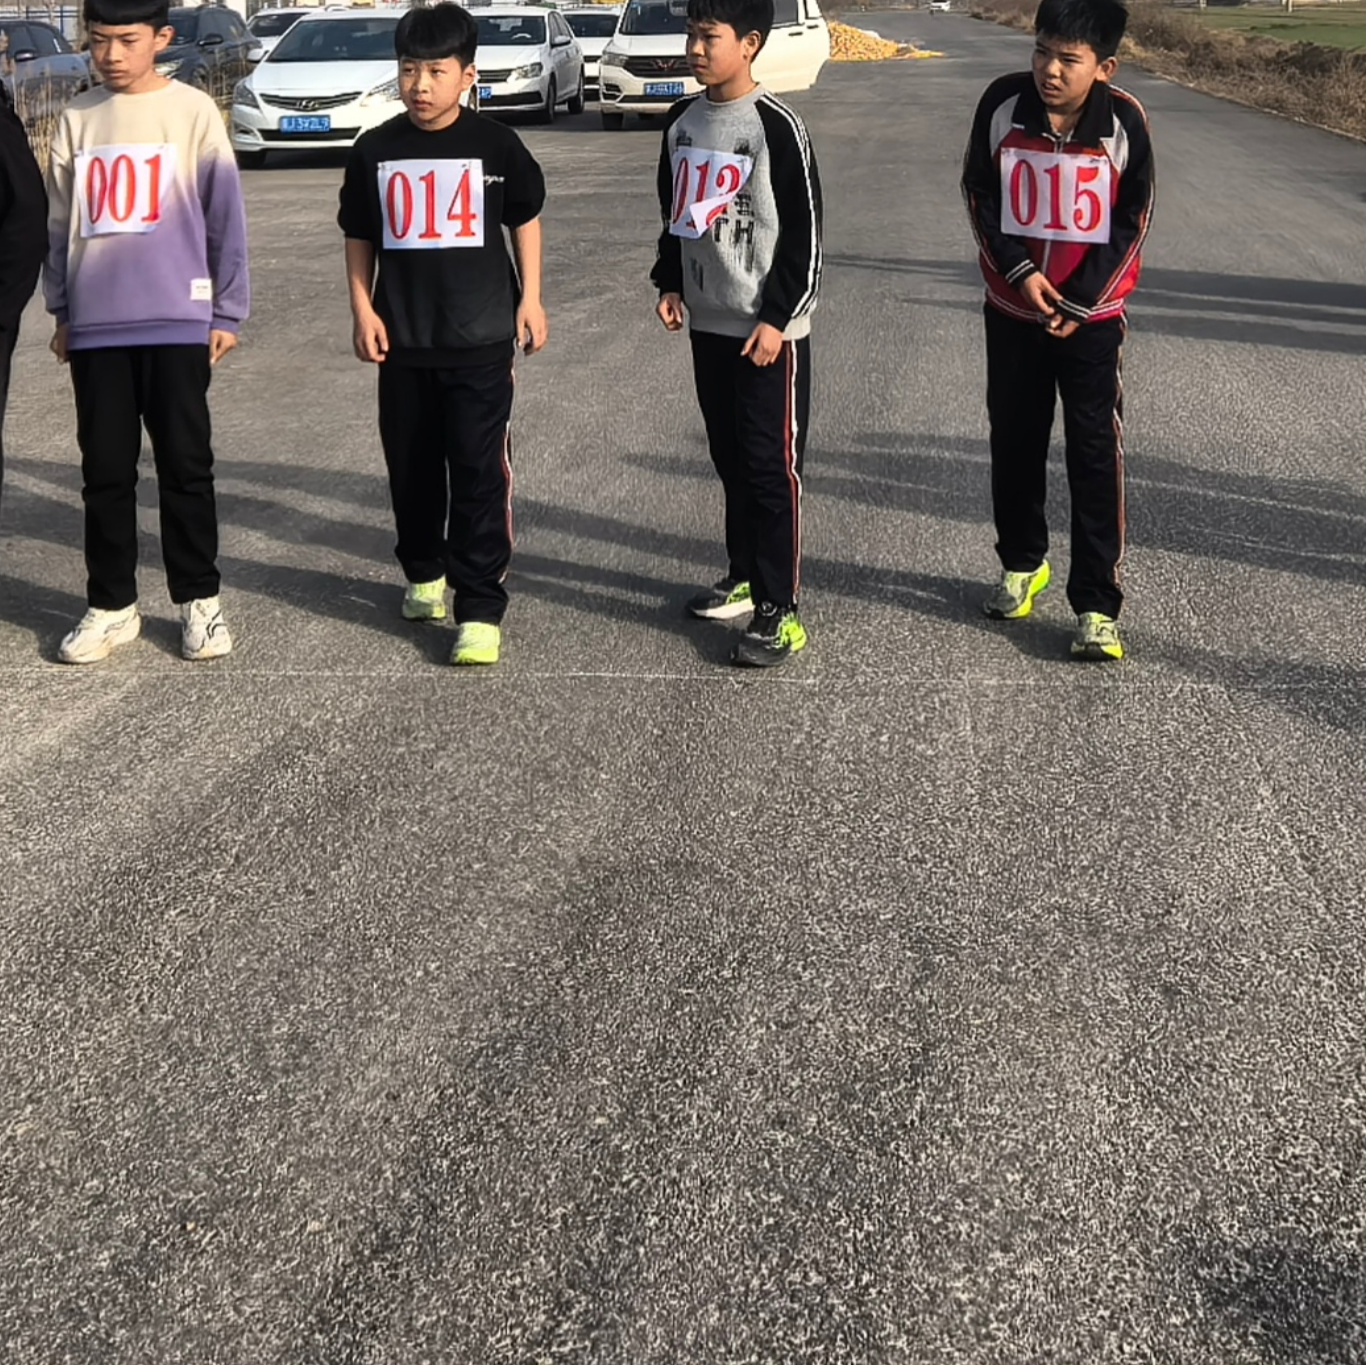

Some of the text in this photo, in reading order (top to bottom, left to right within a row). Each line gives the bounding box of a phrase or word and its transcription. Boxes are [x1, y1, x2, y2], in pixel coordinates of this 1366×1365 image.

[86, 154, 161, 224] 001
[386, 169, 477, 239] 014
[1009, 159, 1101, 232] 015
